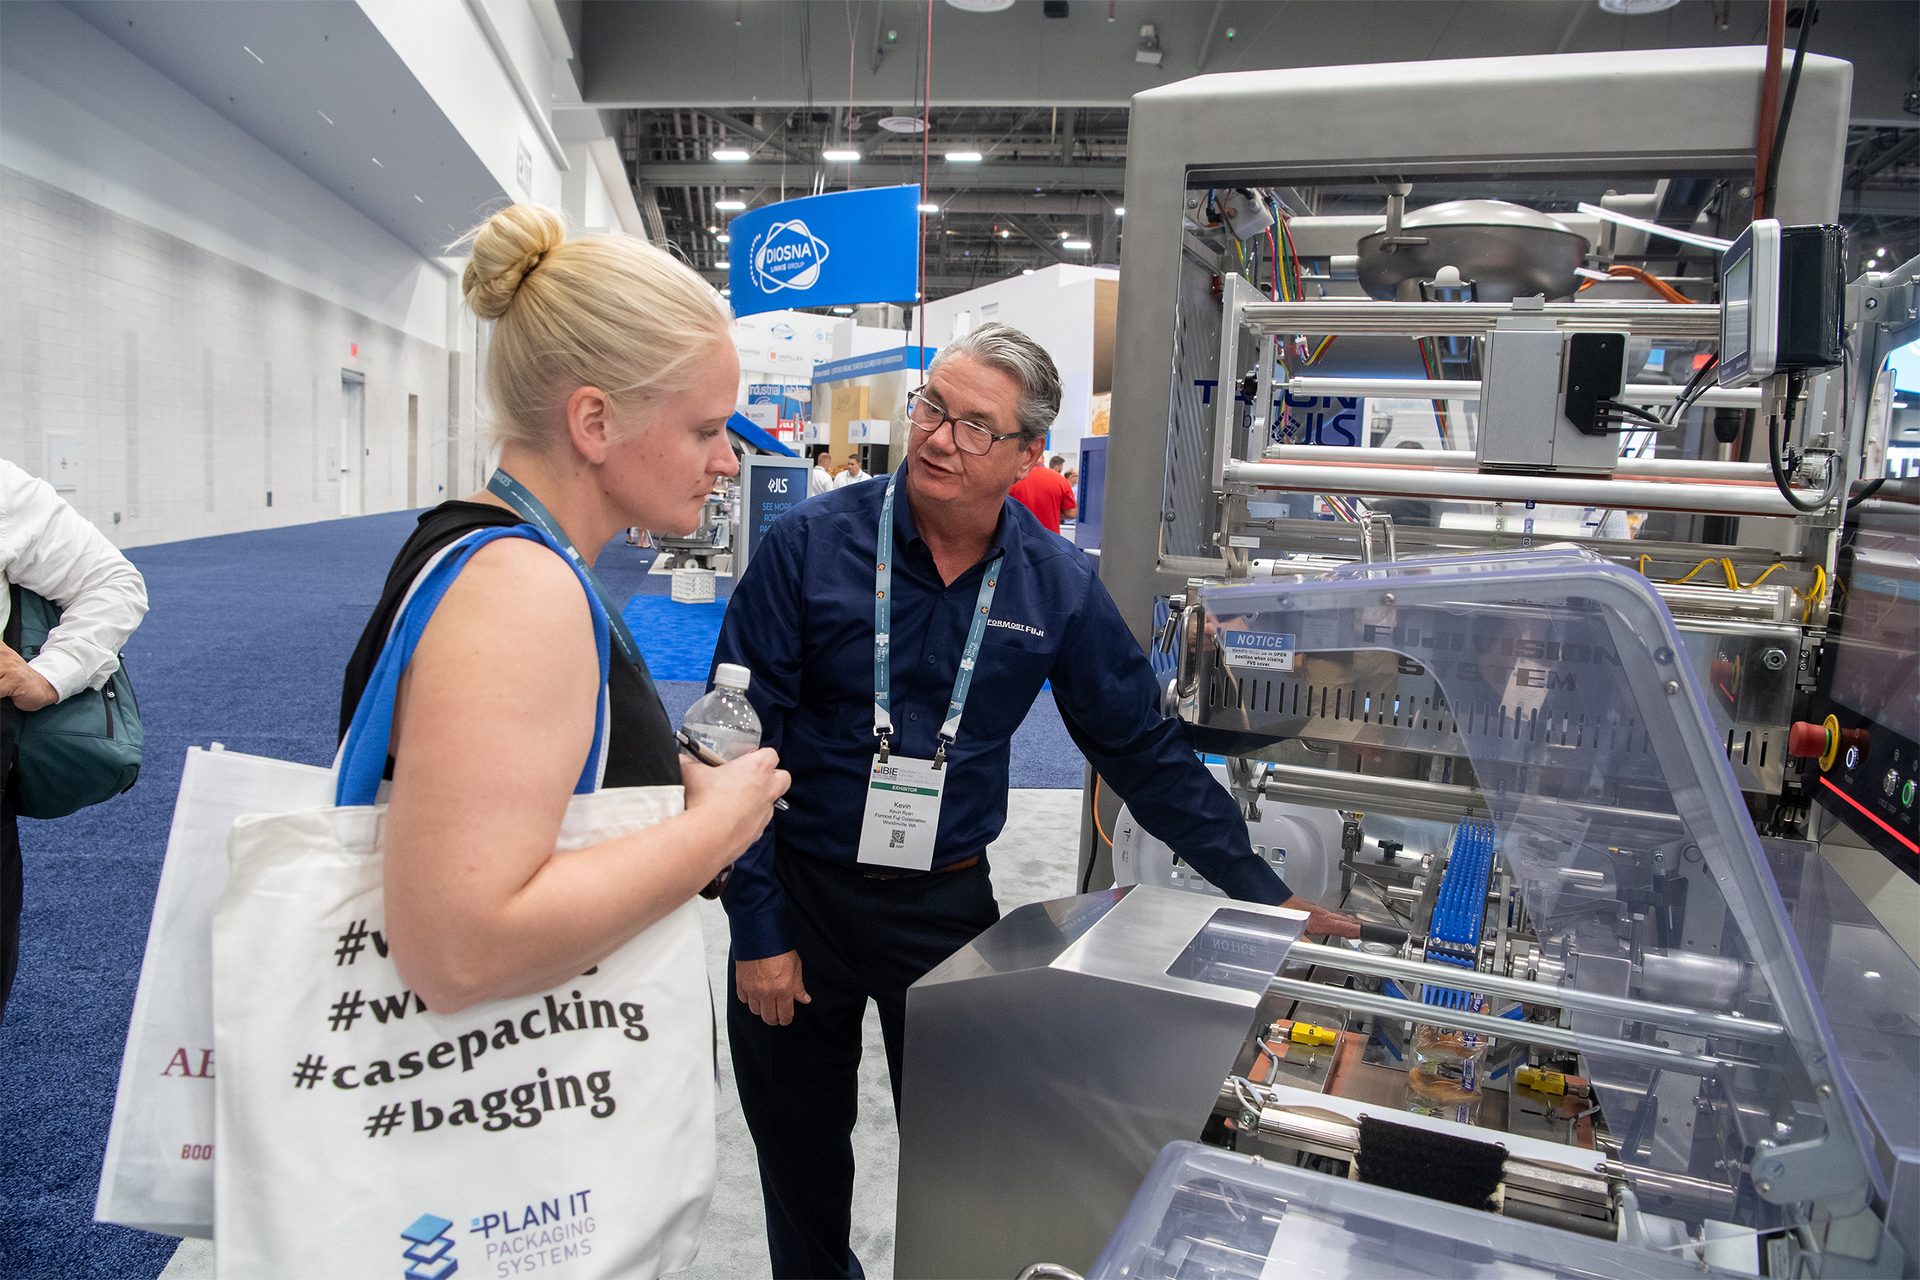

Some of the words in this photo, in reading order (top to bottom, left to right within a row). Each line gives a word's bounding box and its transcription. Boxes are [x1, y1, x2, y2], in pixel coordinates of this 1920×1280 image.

[766, 242, 812, 264] DIOSNA
[748, 384, 780, 395] Industrial
[774, 478, 788, 493] JLS
[762, 502, 774, 511] SEE
[987, 618, 1025, 631] FORMOST
[1025, 625, 1045, 637] FUJI
[1237, 634, 1284, 648] NOTICE
[880, 766, 899, 777] IBIE
[891, 785, 918, 793] EXHIBITOR
[893, 801, 912, 810] Kevin
[901, 816, 927, 824] Corporation
[293, 990, 649, 1091] #casepacking
[364, 1067, 616, 1138] #bagging
[473, 1198, 560, 1239] PLAN
[570, 1189, 591, 1217] IT
[486, 1216, 597, 1260] PACKAGING
[497, 1238, 592, 1278] SYSTEMS
